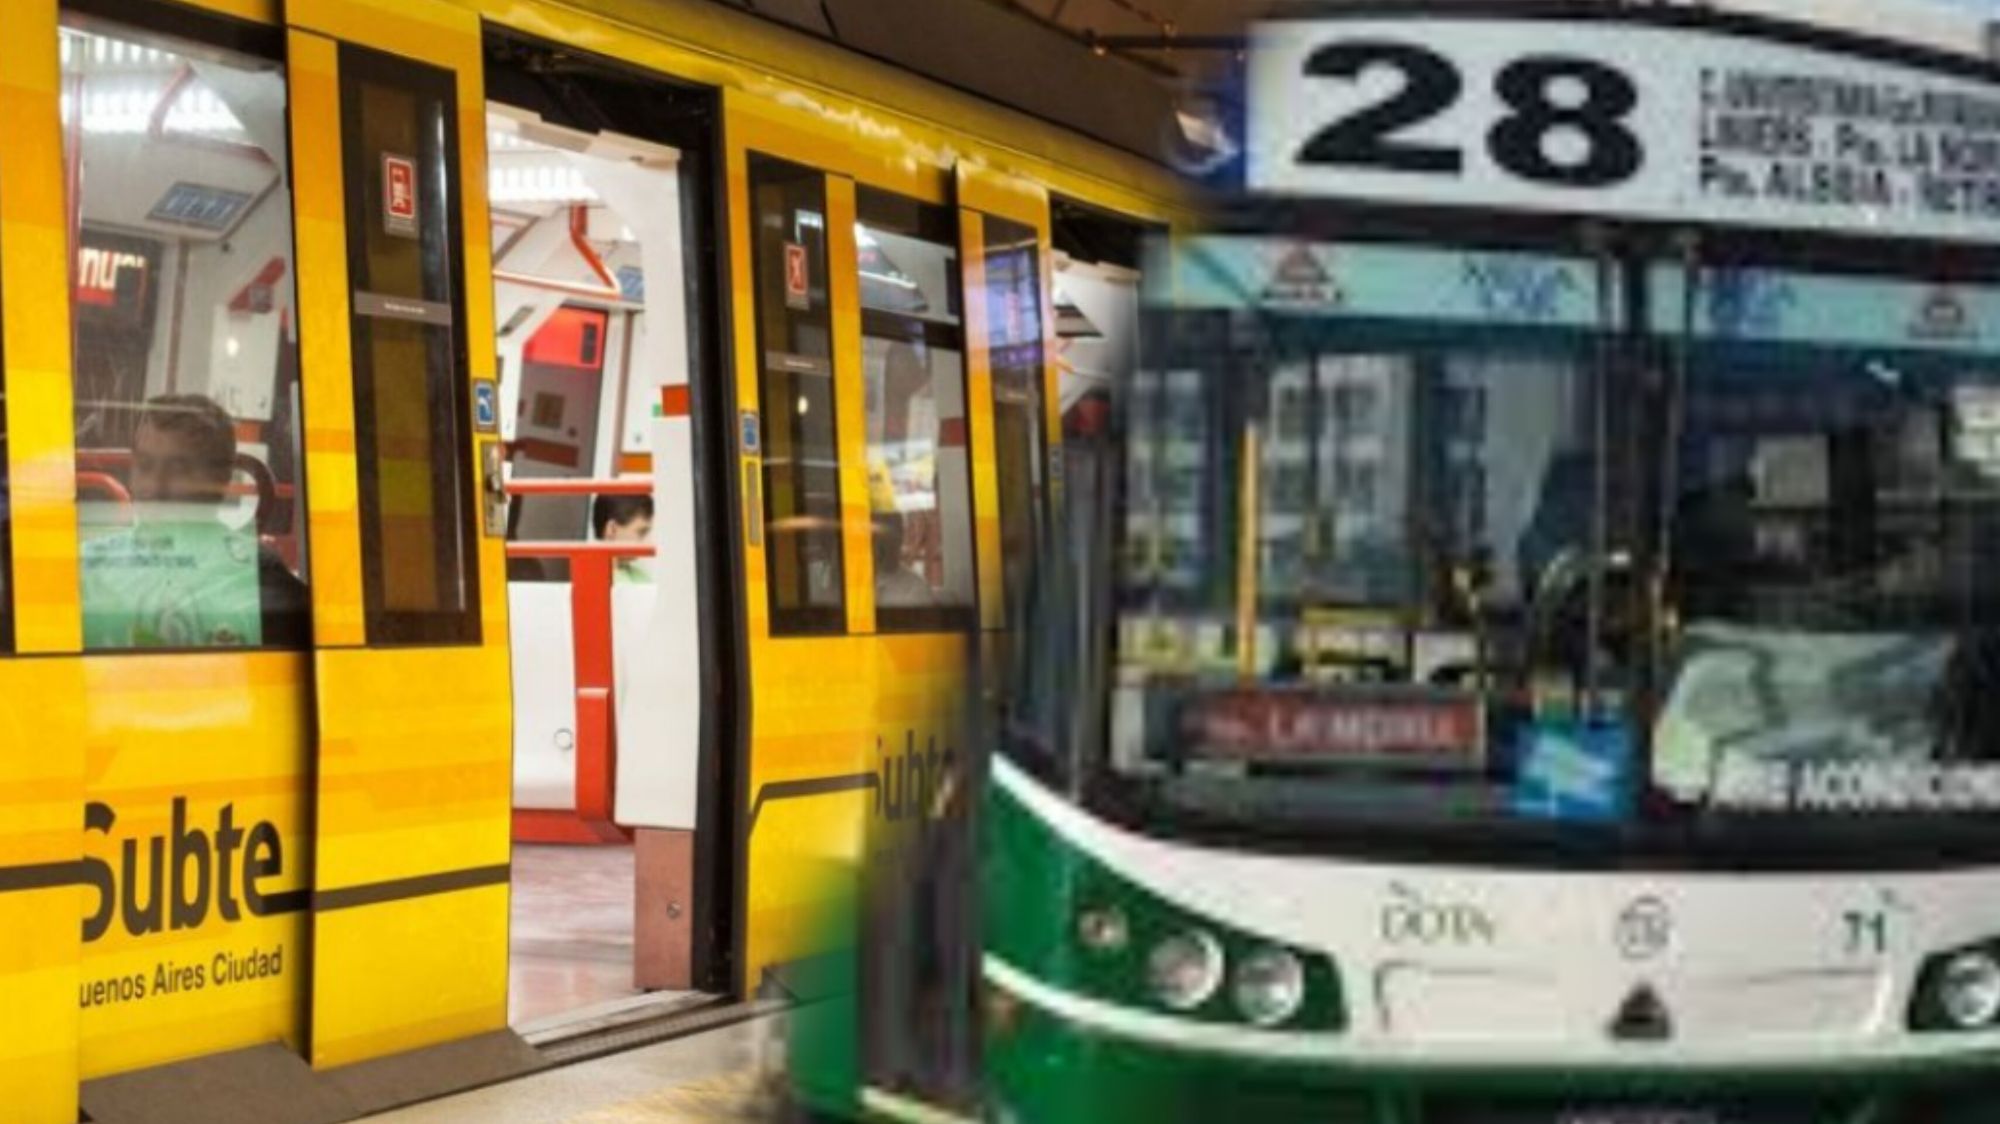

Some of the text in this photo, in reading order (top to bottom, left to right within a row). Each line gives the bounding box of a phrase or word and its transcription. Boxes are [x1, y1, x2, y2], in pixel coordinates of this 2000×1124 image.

[1293, 42, 1646, 188] 28
[81, 796, 283, 944] Subte
[79, 944, 283, 1008] uenos Aires Ciudad
[1842, 910, 1885, 955] 71
